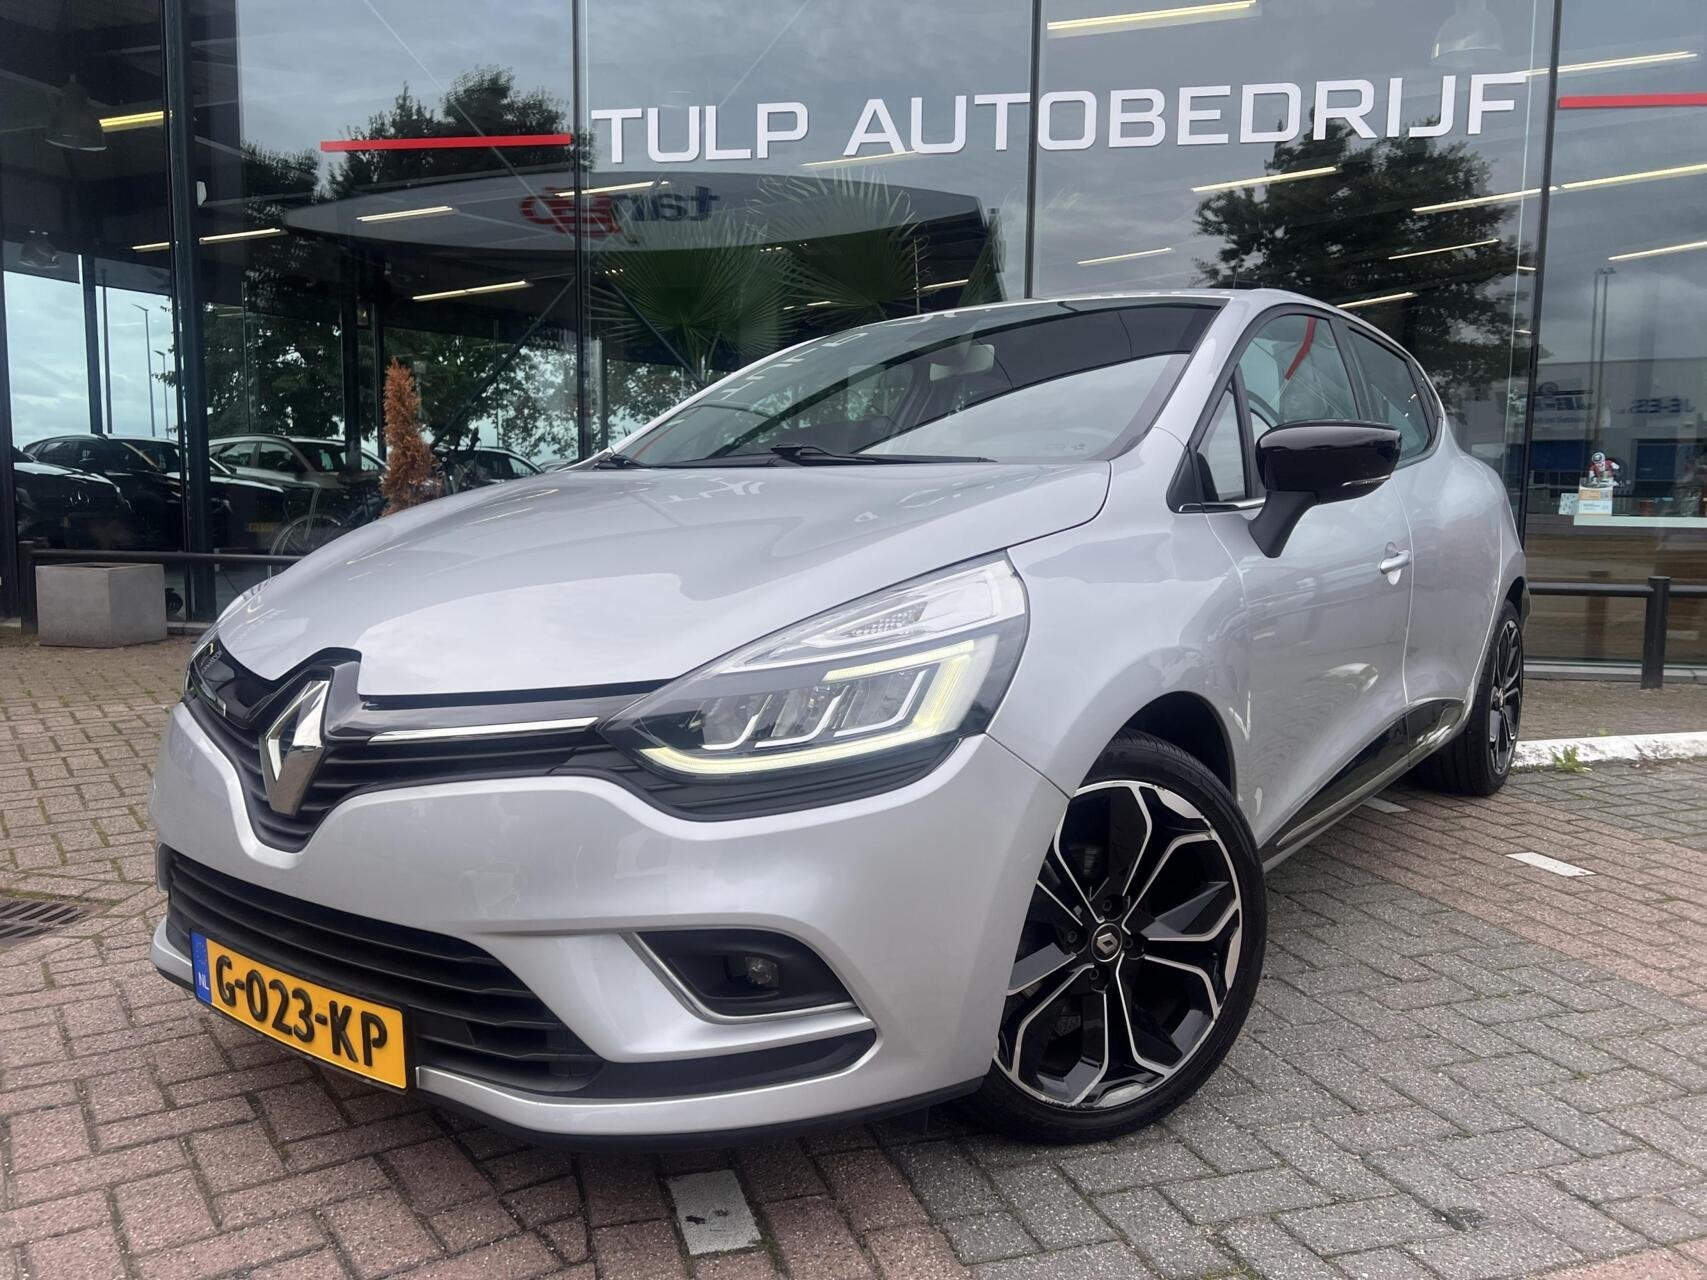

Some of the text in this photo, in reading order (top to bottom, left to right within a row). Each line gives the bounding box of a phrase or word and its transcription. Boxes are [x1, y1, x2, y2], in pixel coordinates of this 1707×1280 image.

[591, 72, 1527, 164] TULP AUTOBEDRIJF
[198, 972, 209, 991] NL
[215, 954, 388, 1067] G-023-KP
